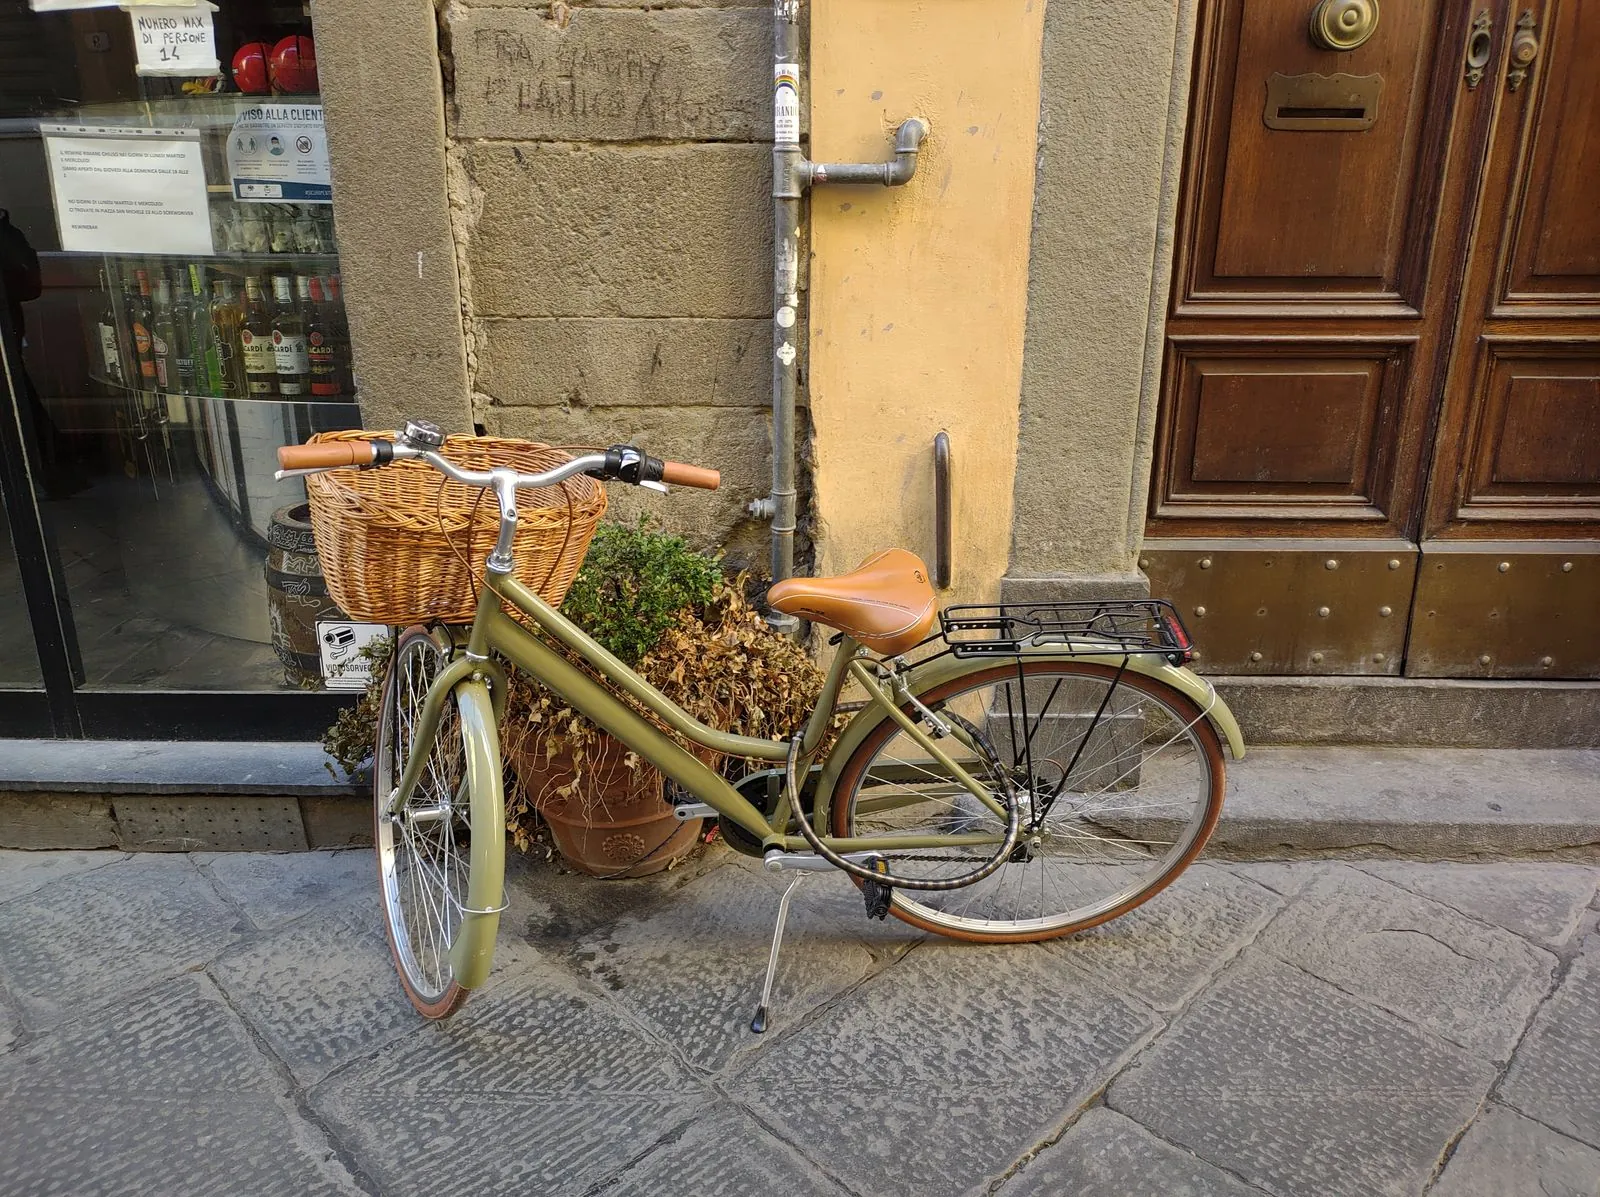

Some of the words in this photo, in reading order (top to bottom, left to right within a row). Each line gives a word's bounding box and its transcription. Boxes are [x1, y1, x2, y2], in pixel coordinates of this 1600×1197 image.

[138, 16, 177, 30] NUMERO
[183, 16, 204, 29] MAX
[143, 33, 152, 44] DI
[163, 32, 206, 44] PERSONE
[160, 46, 180, 61] 14
[266, 109, 289, 120] ALLA
